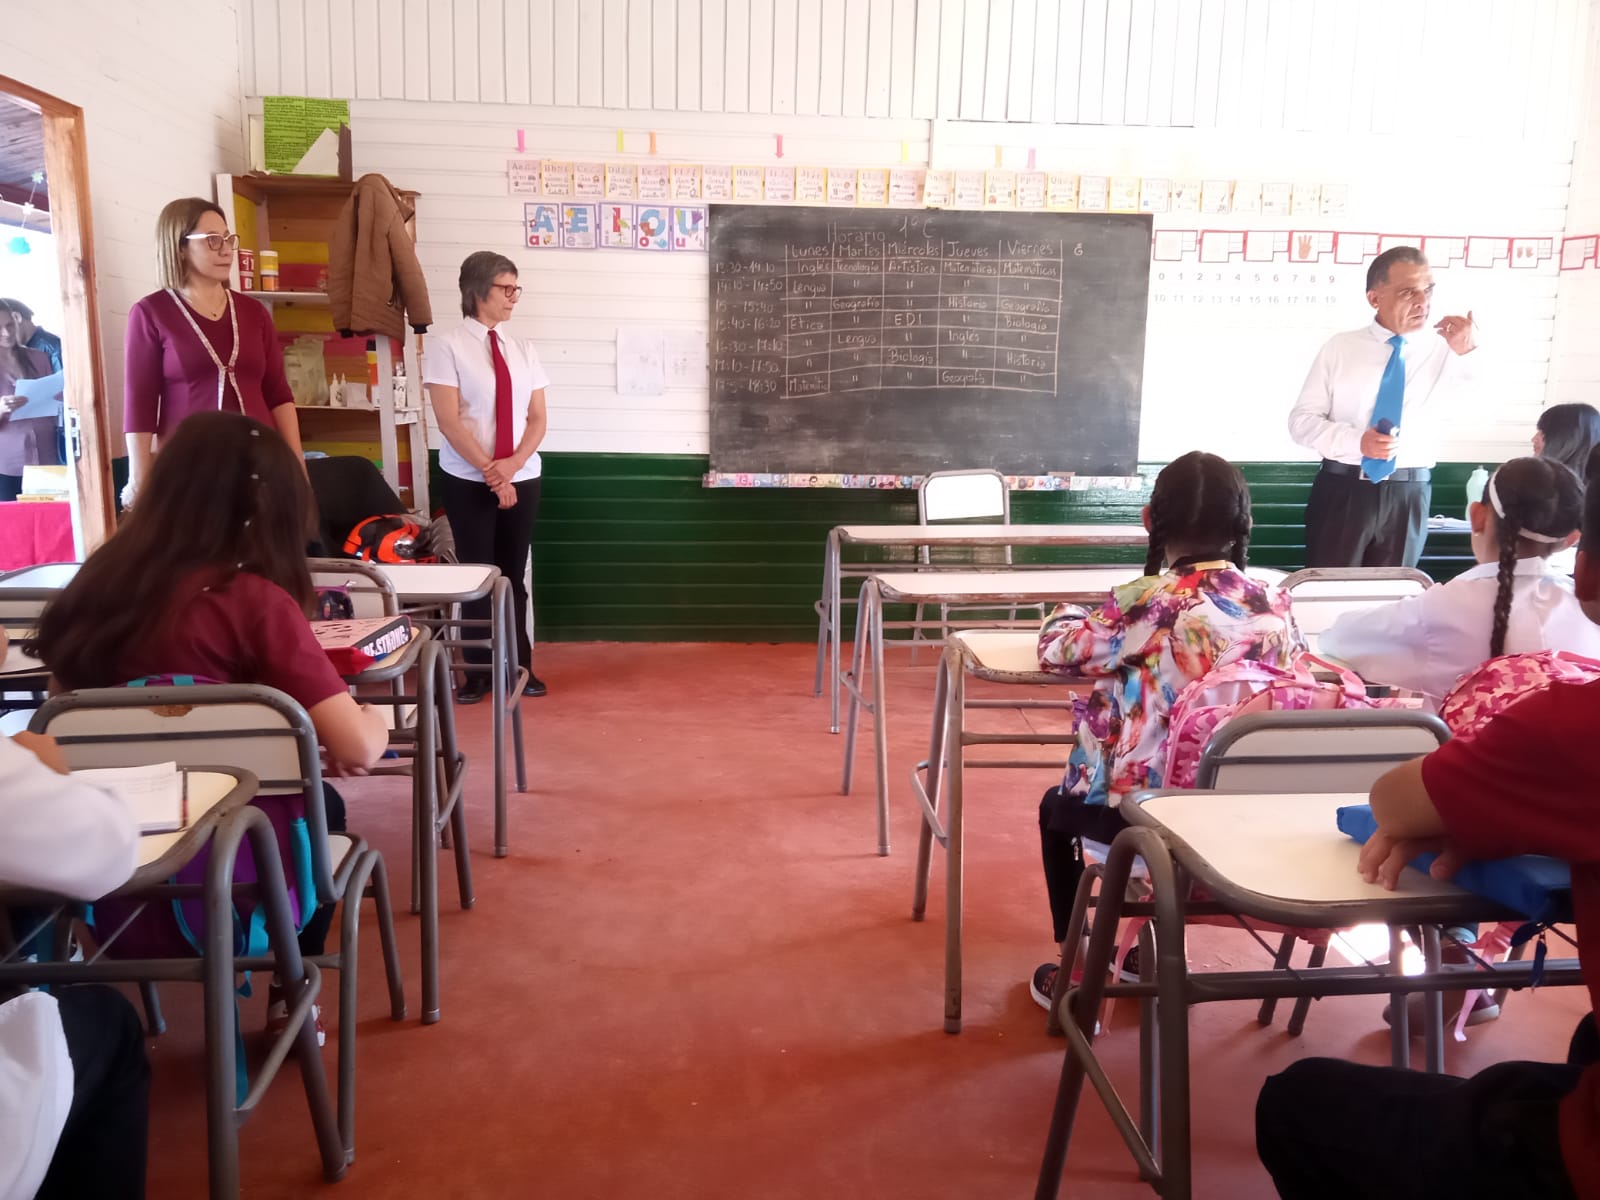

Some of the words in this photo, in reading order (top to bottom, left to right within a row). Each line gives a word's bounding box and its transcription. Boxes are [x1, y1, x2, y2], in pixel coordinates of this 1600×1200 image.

[531, 206, 554, 232] A
[569, 208, 588, 233] E
[639, 209, 666, 237] O
[678, 210, 700, 235] U
[529, 235, 540, 246] a
[639, 237, 649, 247] o
[676, 238, 685, 247] u
[827, 222, 885, 243] Horario
[792, 245, 829, 258] Lunes
[839, 243, 881, 257] Martes
[947, 241, 989, 257] Jueves
[1007, 240, 1054, 257] Viernes
